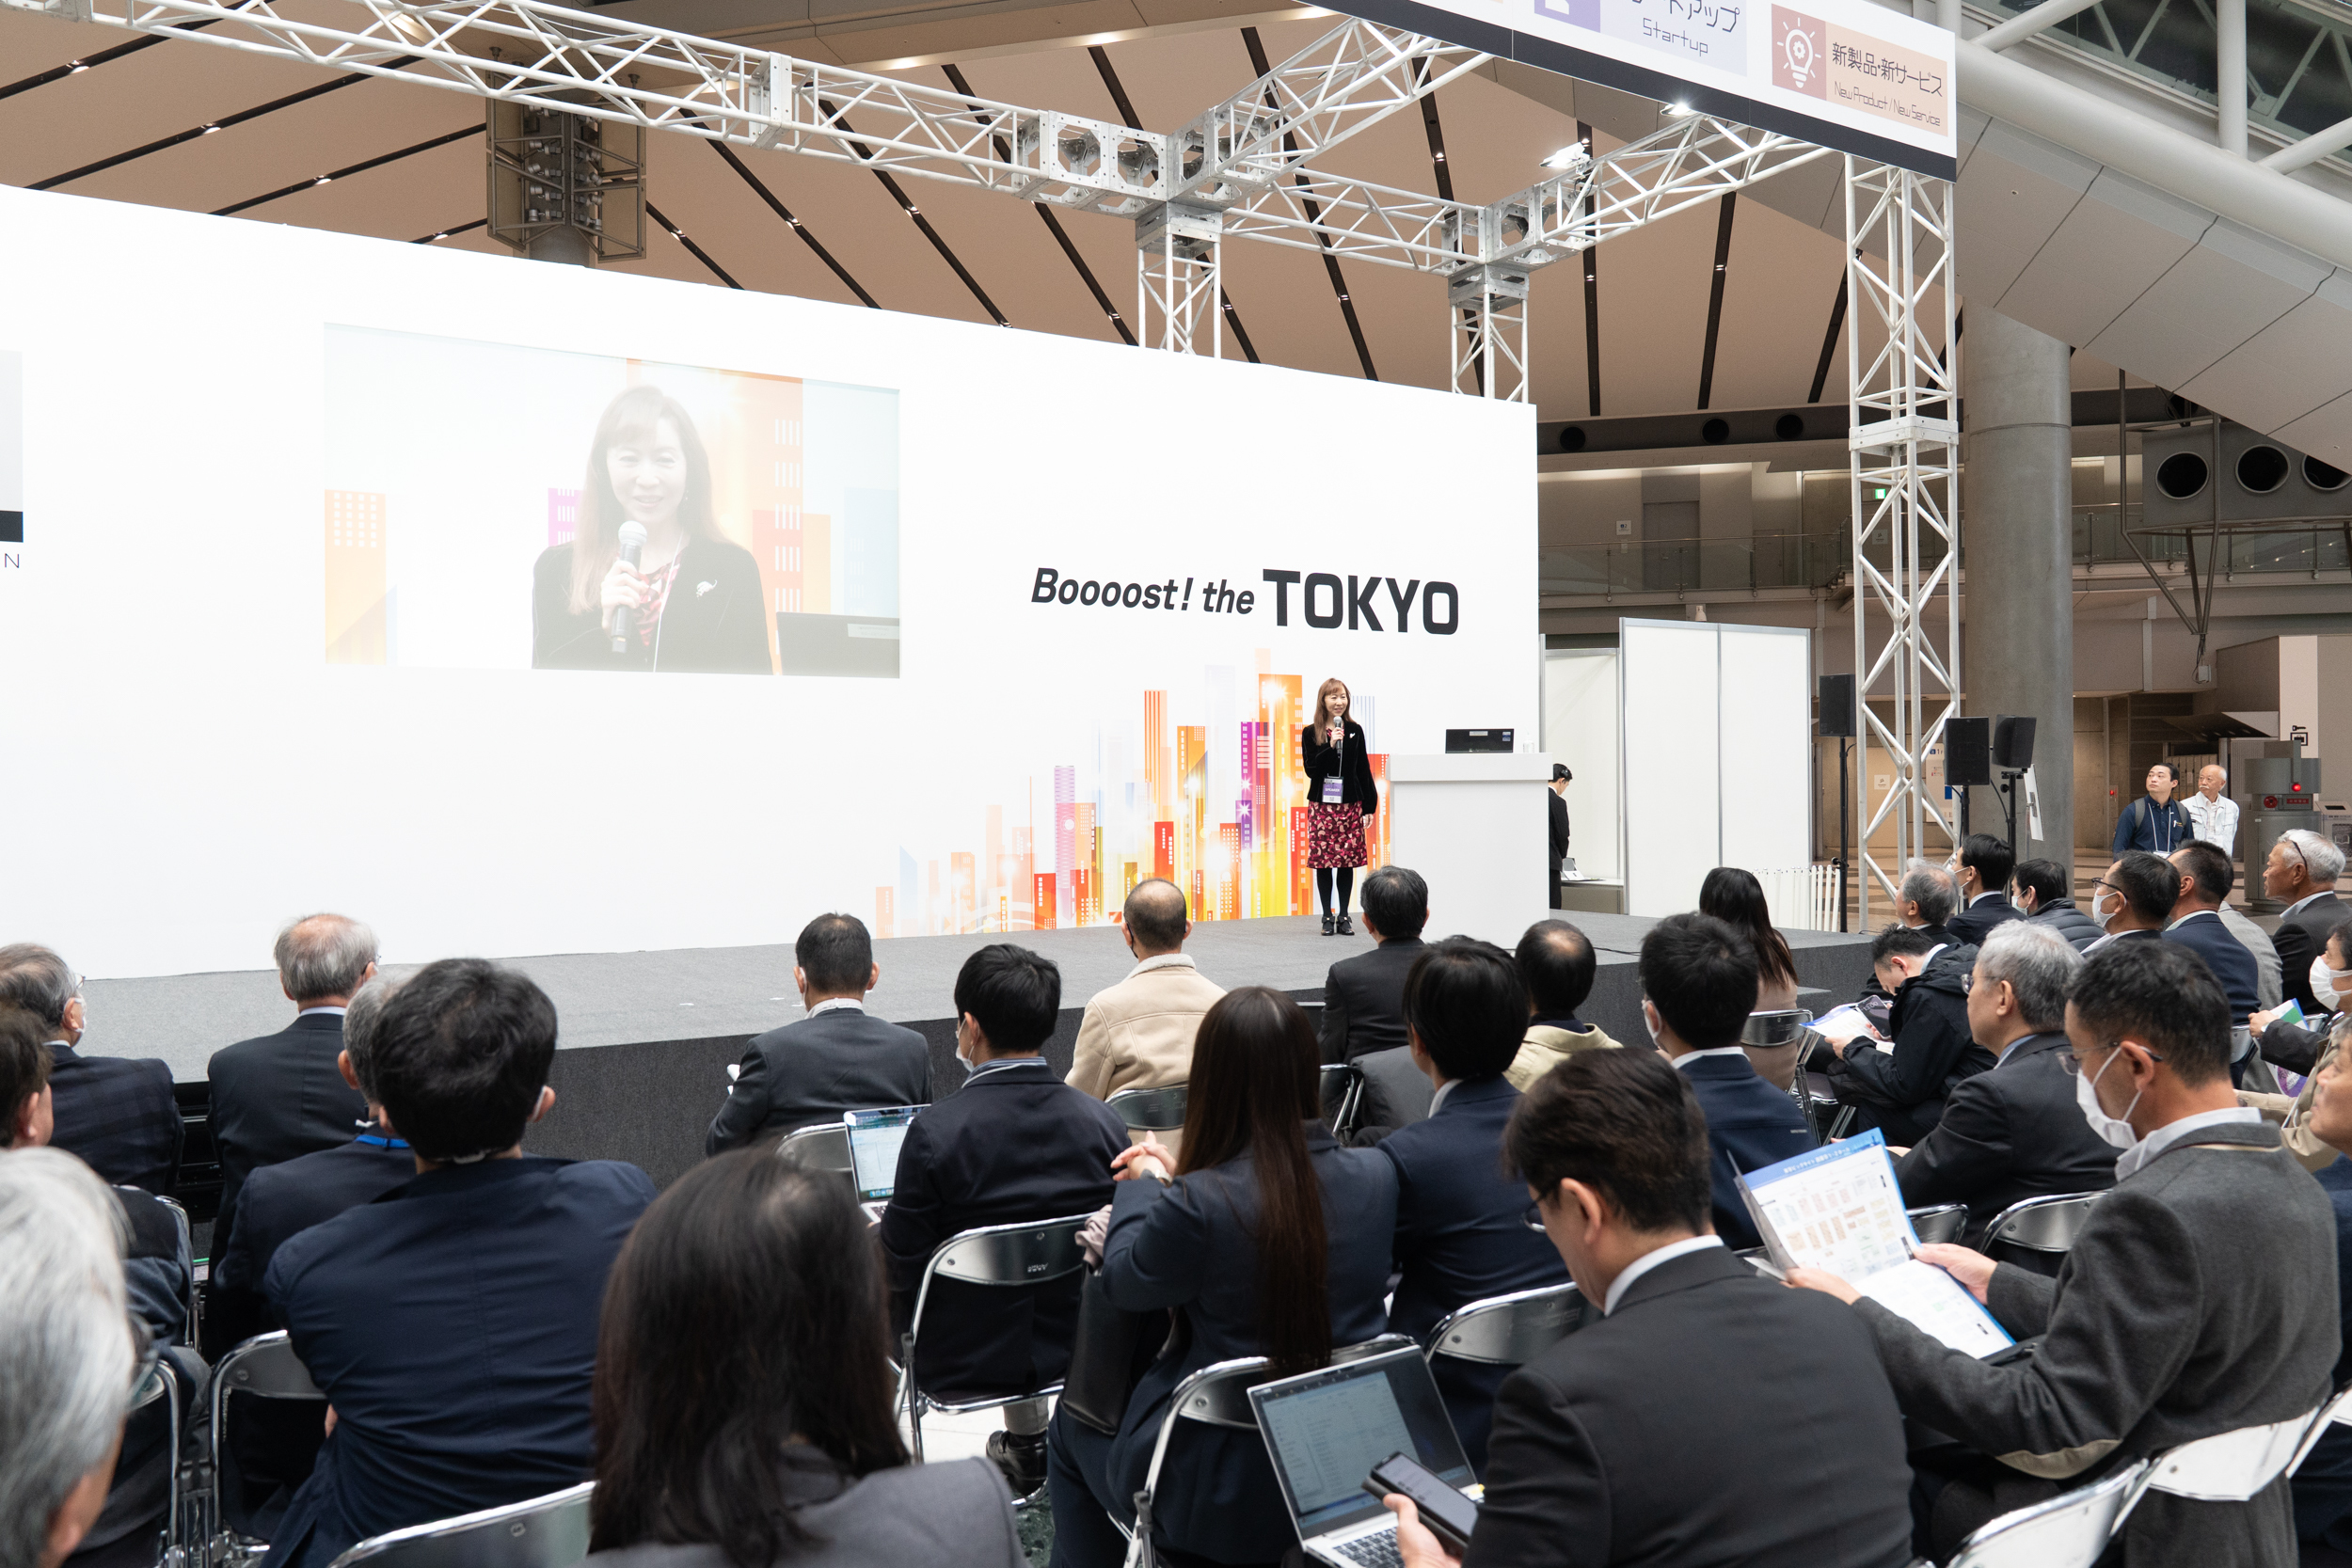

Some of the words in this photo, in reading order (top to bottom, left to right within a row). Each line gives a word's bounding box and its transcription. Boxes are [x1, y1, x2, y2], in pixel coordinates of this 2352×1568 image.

[1632, 0, 1740, 32] トアップ
[1643, 17, 1708, 56] Startup
[1832, 41, 1943, 97] 新製品・新サービス
[1834, 81, 1852, 100] New
[1853, 86, 1888, 110] Product
[1893, 98, 1912, 117] New
[1911, 104, 1941, 127] Service
[1031, 567, 1194, 611] Boooost!
[1202, 578, 1255, 614] the
[1263, 568, 1459, 635] TOKYO
